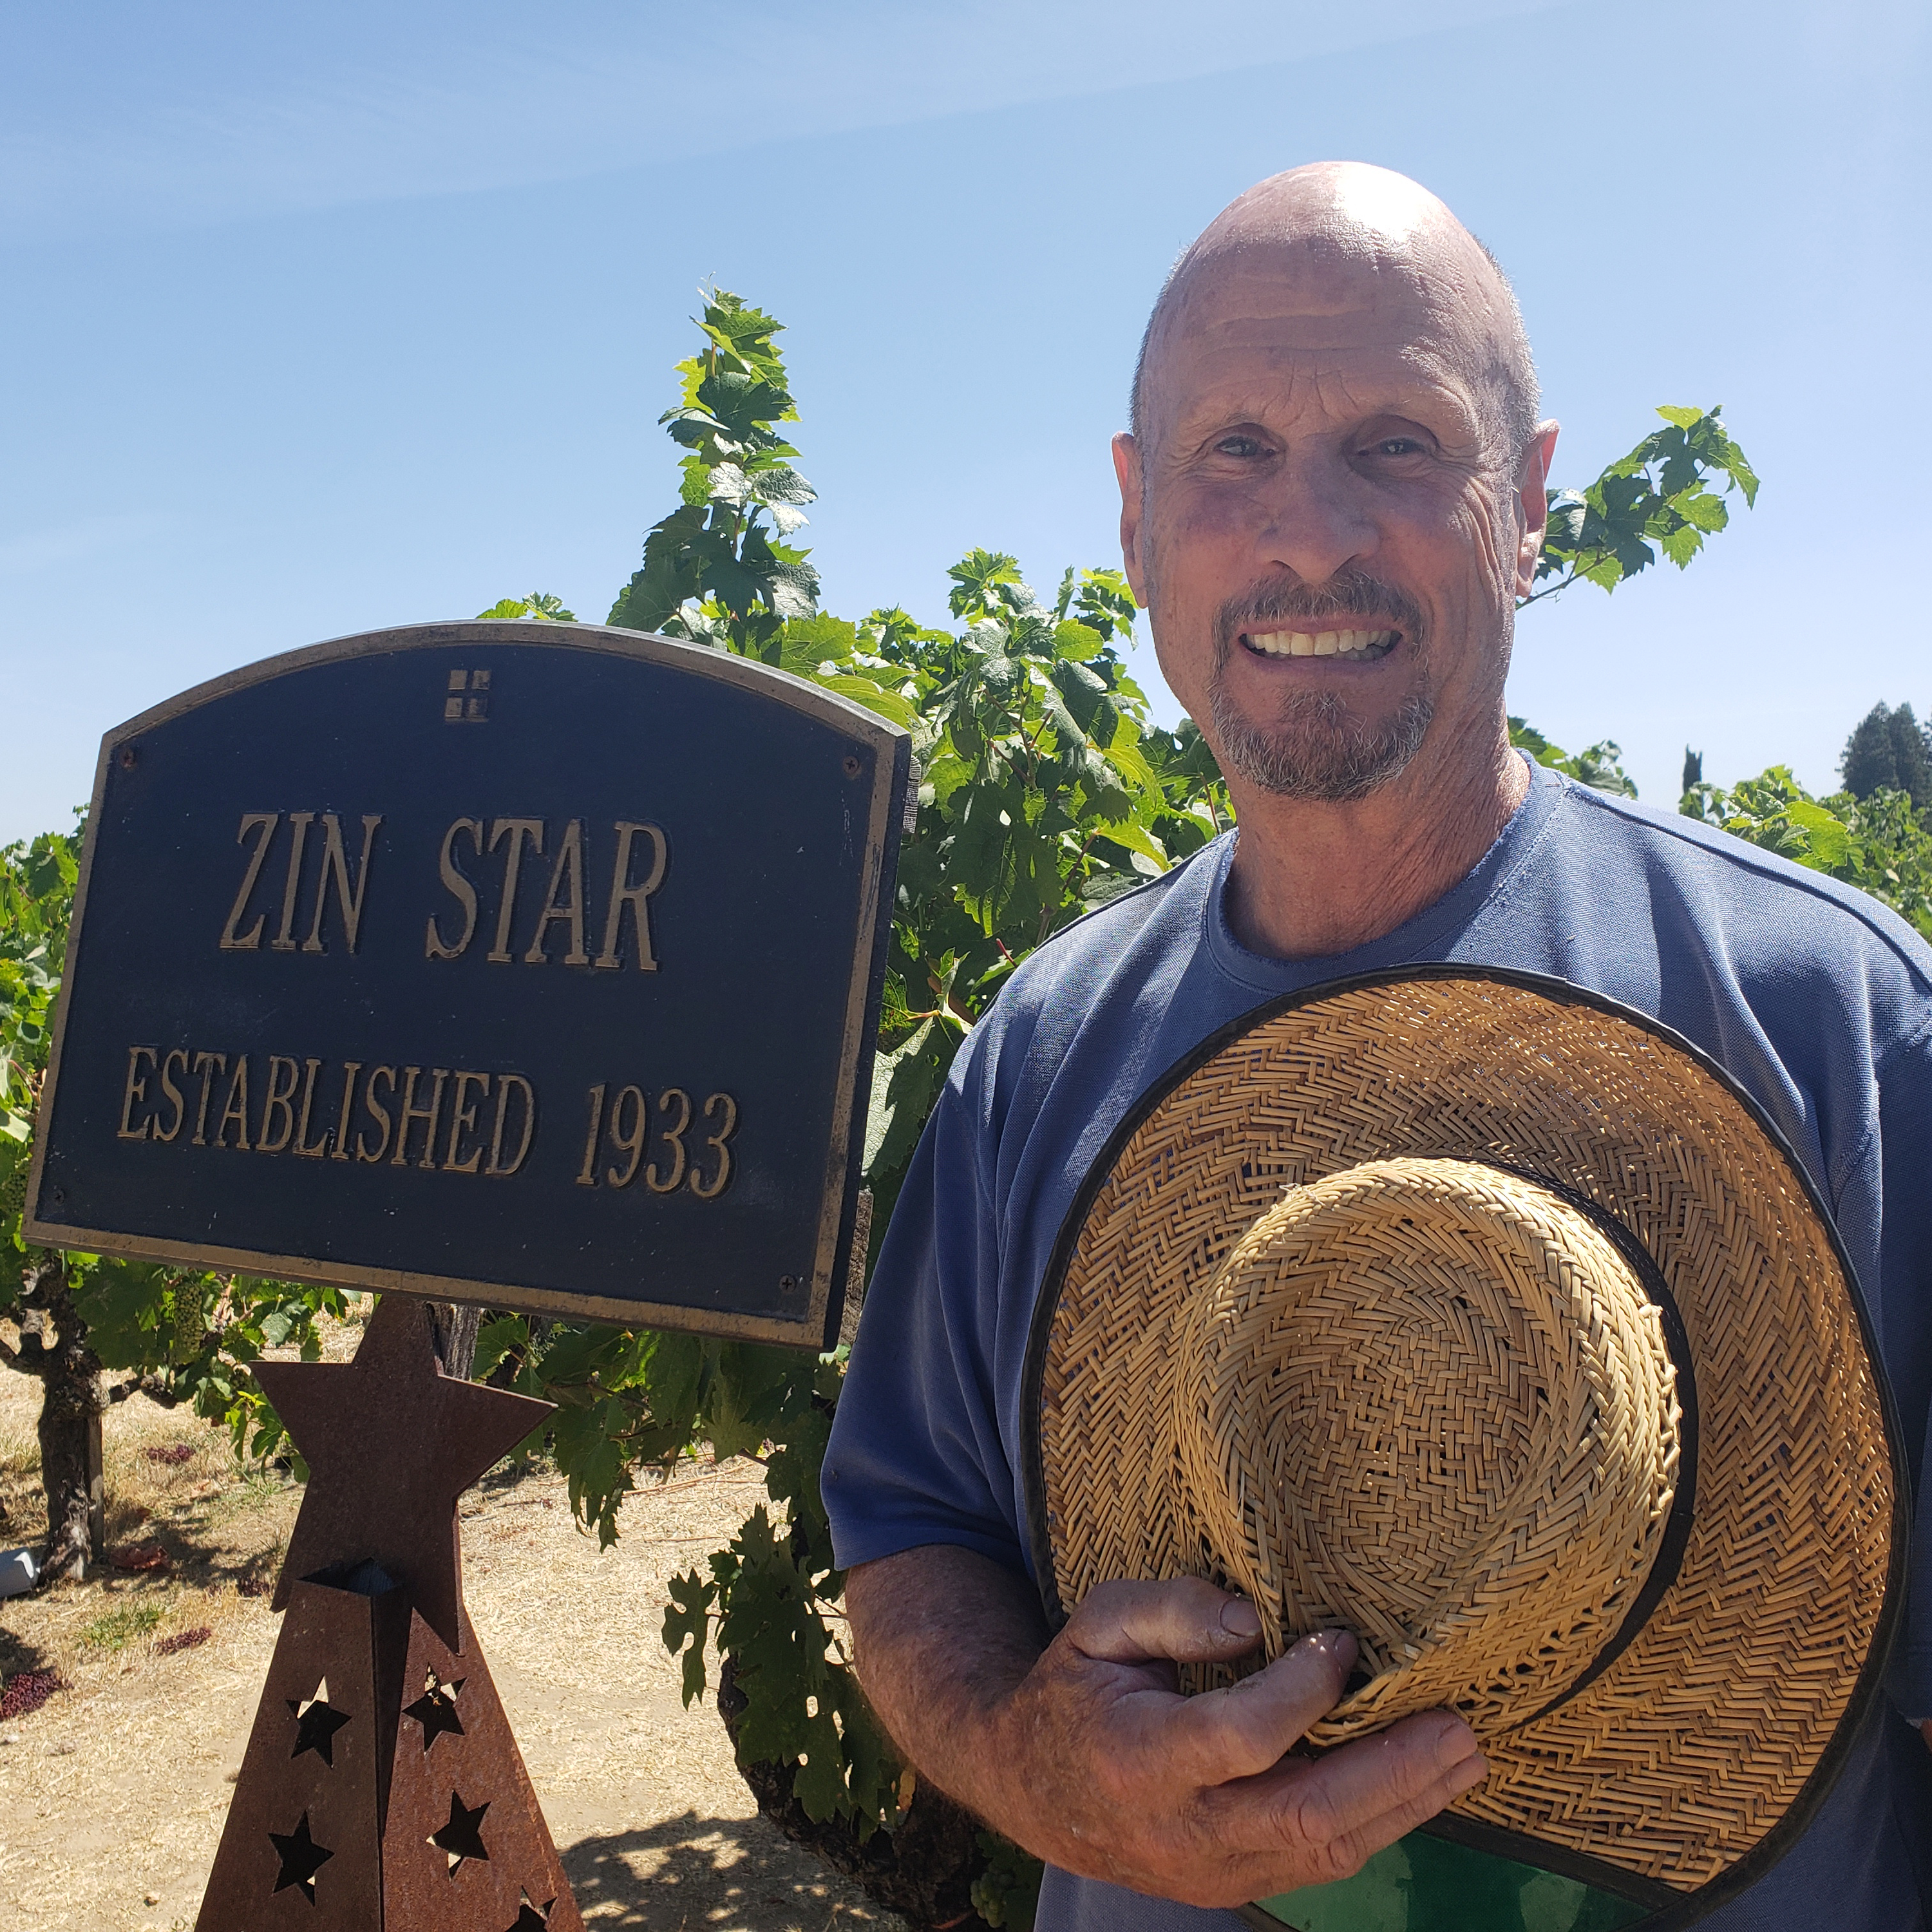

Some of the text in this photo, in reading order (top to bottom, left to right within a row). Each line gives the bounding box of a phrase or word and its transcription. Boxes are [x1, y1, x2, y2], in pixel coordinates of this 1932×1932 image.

[219, 812, 668, 971] ZIN STAR
[117, 1046, 739, 1198] ESTABLISHED 1933
